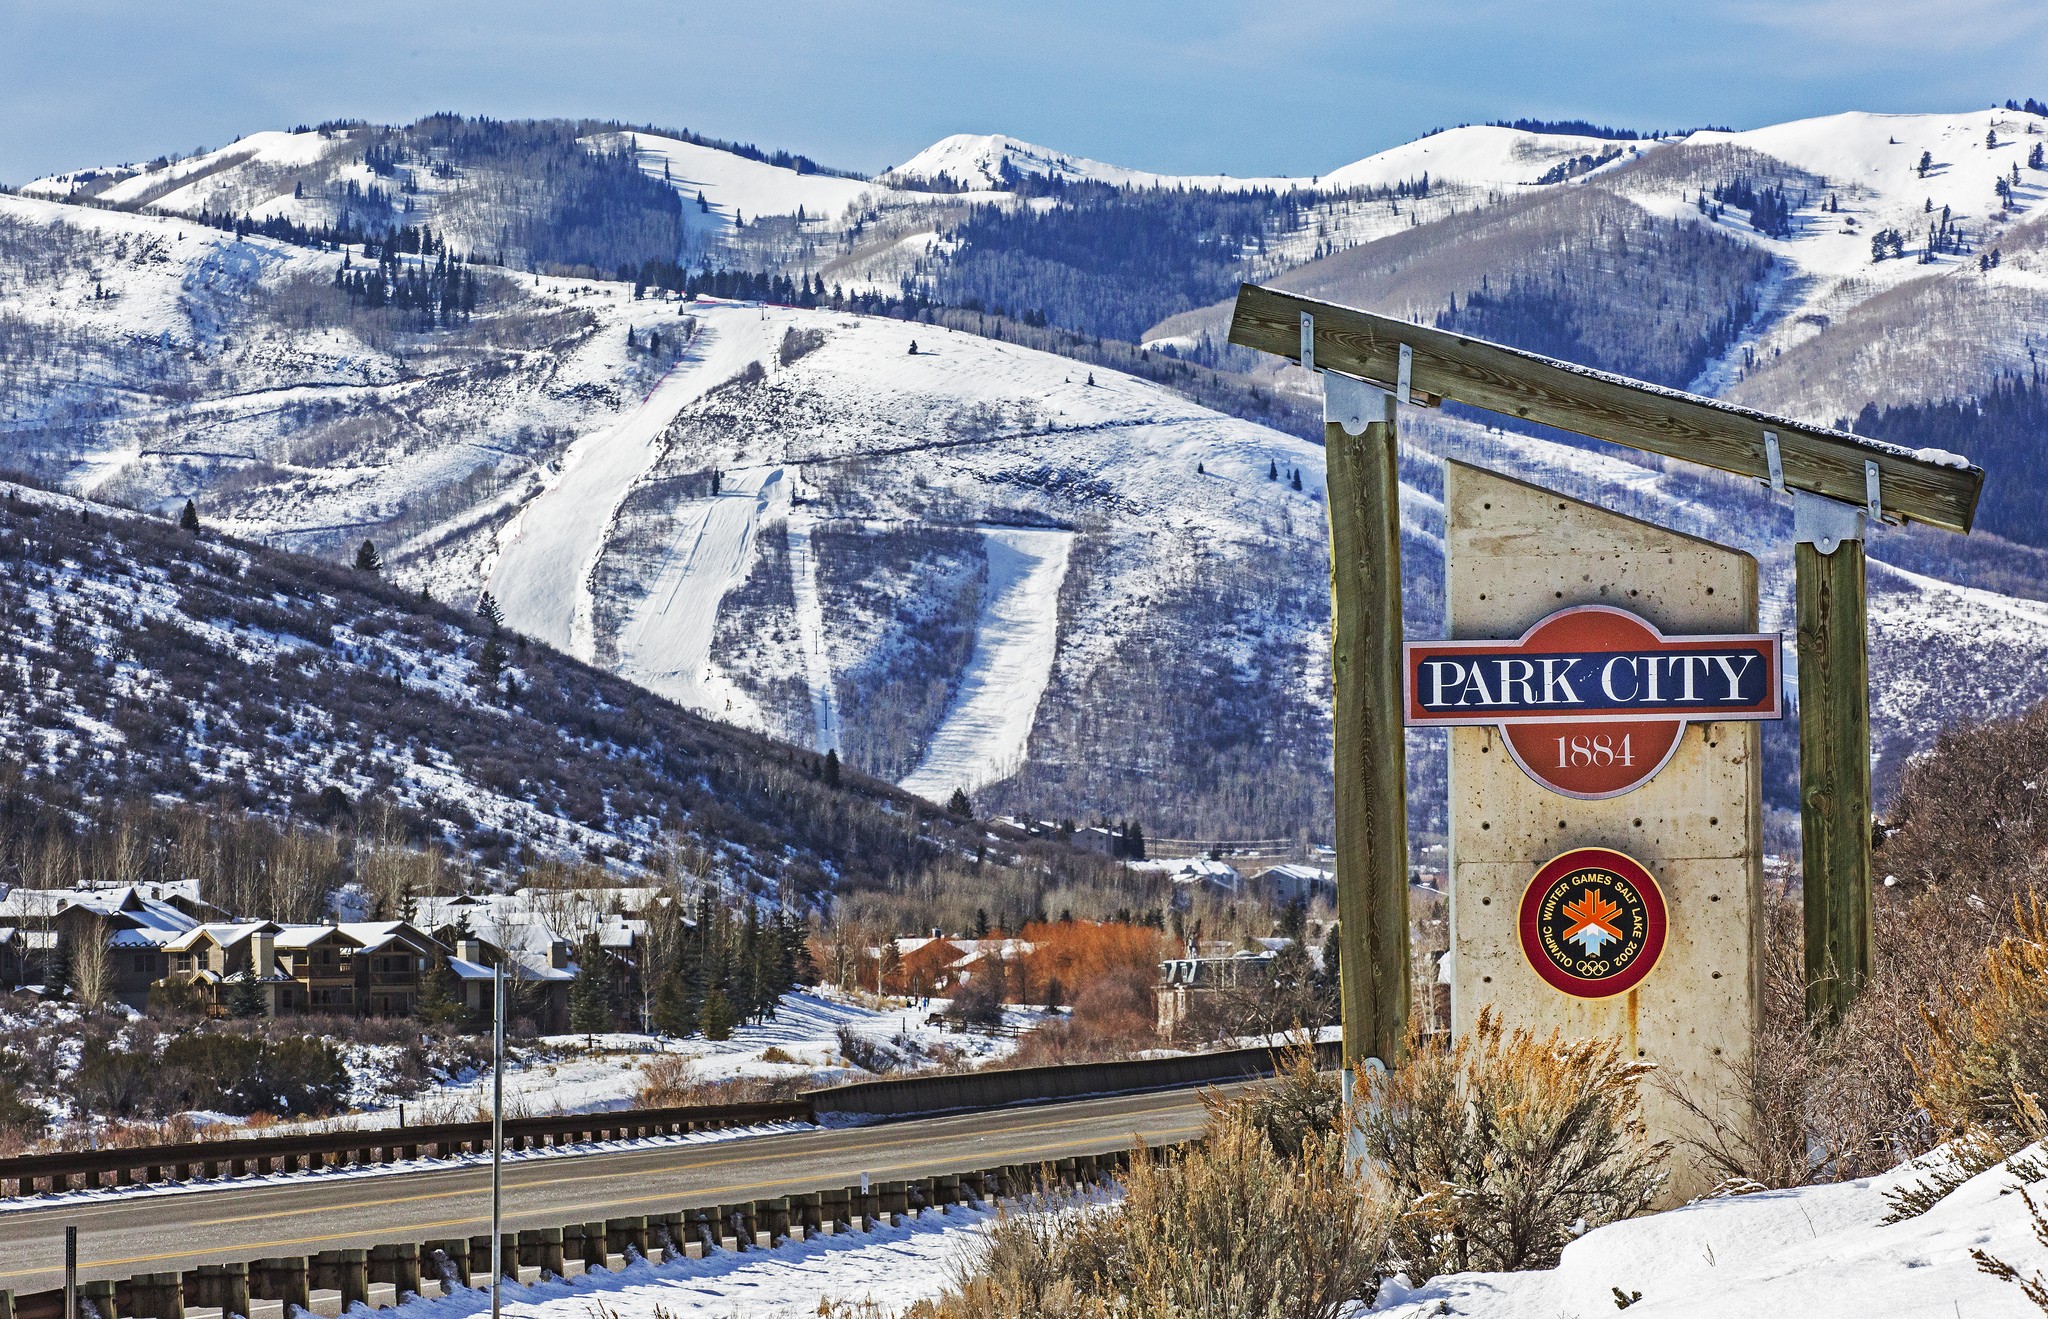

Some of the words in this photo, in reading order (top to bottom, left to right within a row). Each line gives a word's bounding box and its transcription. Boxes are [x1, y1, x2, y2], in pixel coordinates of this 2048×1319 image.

[1423, 658, 1585, 707] PARK
[1601, 655, 1757, 702] CITY
[1554, 733, 1635, 769] 1884
[1572, 874, 1612, 885] GAMES
[1614, 881, 1638, 905] SALT
[1543, 882, 1570, 921] WINTER
[1632, 908, 1642, 938] LAKE
[1543, 925, 1573, 968] OLYMPIC
[1614, 941, 1638, 967] 2002
